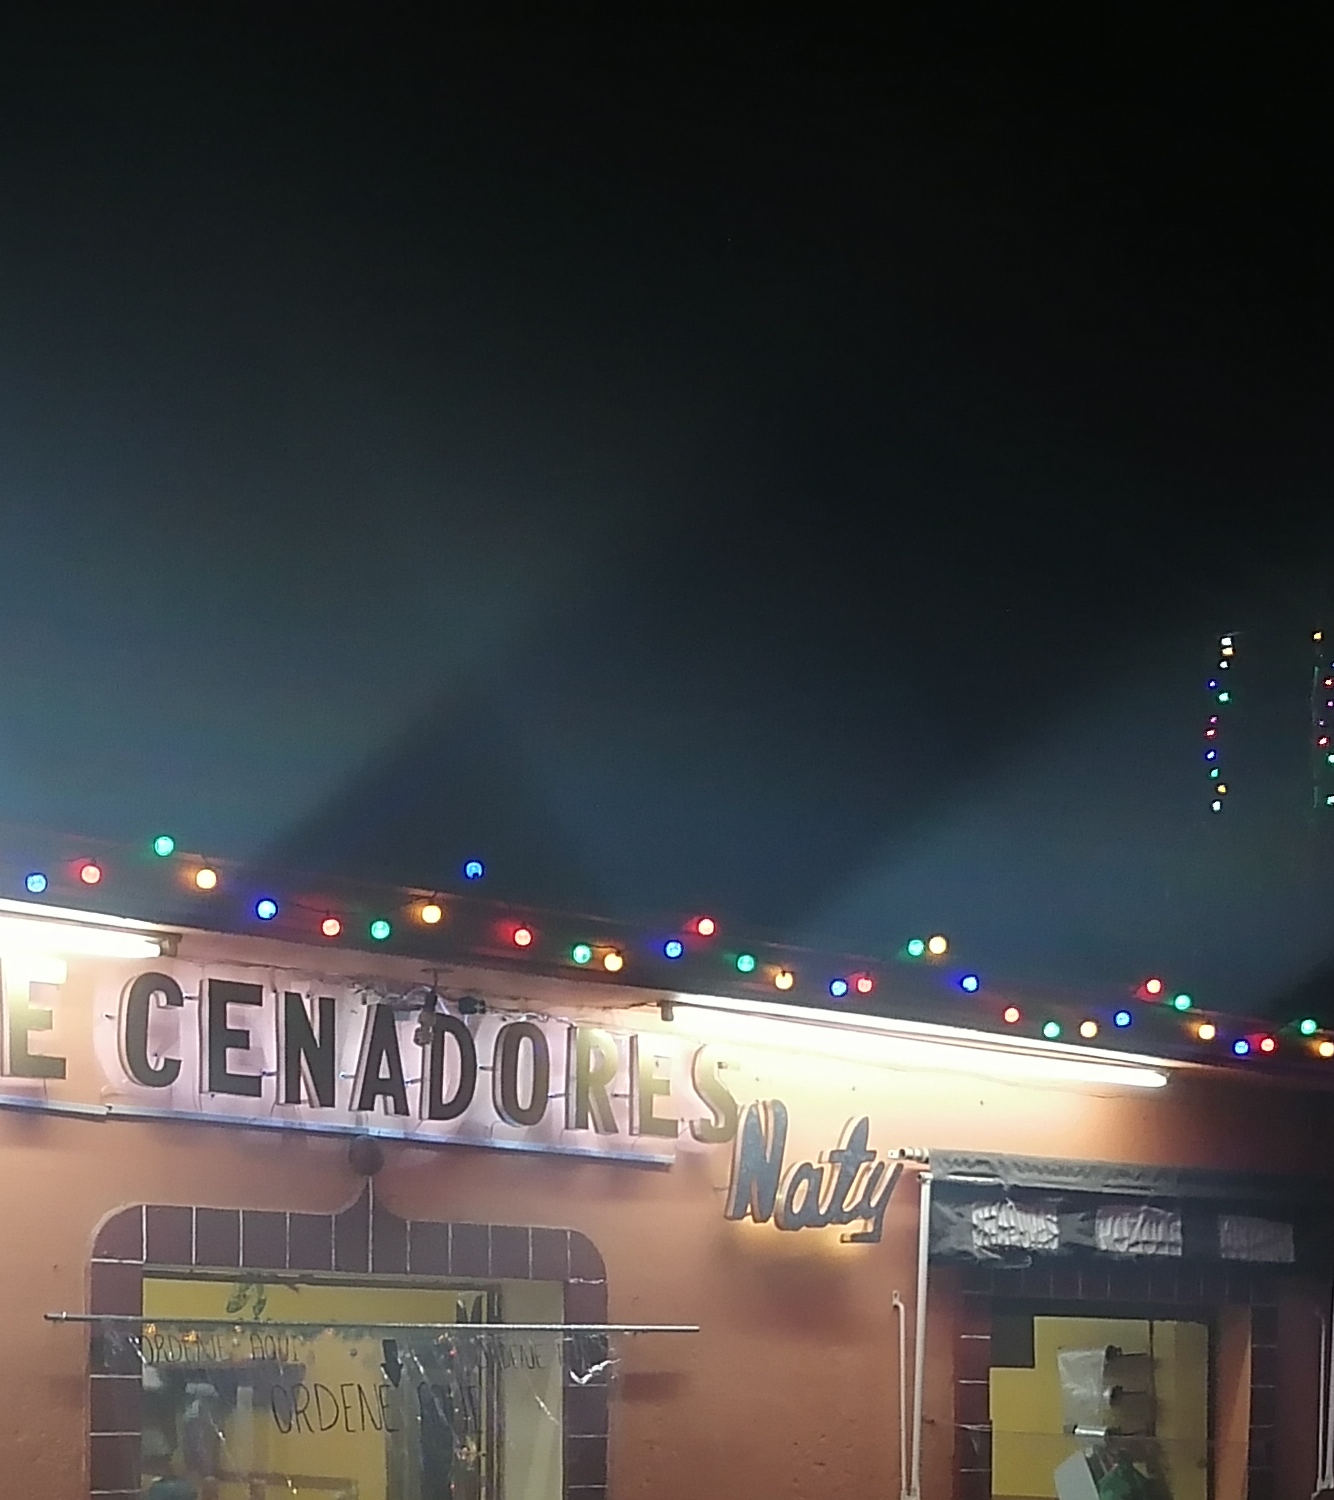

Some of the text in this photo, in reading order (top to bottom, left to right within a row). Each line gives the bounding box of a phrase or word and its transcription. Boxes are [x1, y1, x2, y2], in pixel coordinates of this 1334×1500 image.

[118, 970, 738, 1144] CENADORES
[724, 1098, 904, 1243] Naty
[270, 1382, 400, 1434] ORDENE
